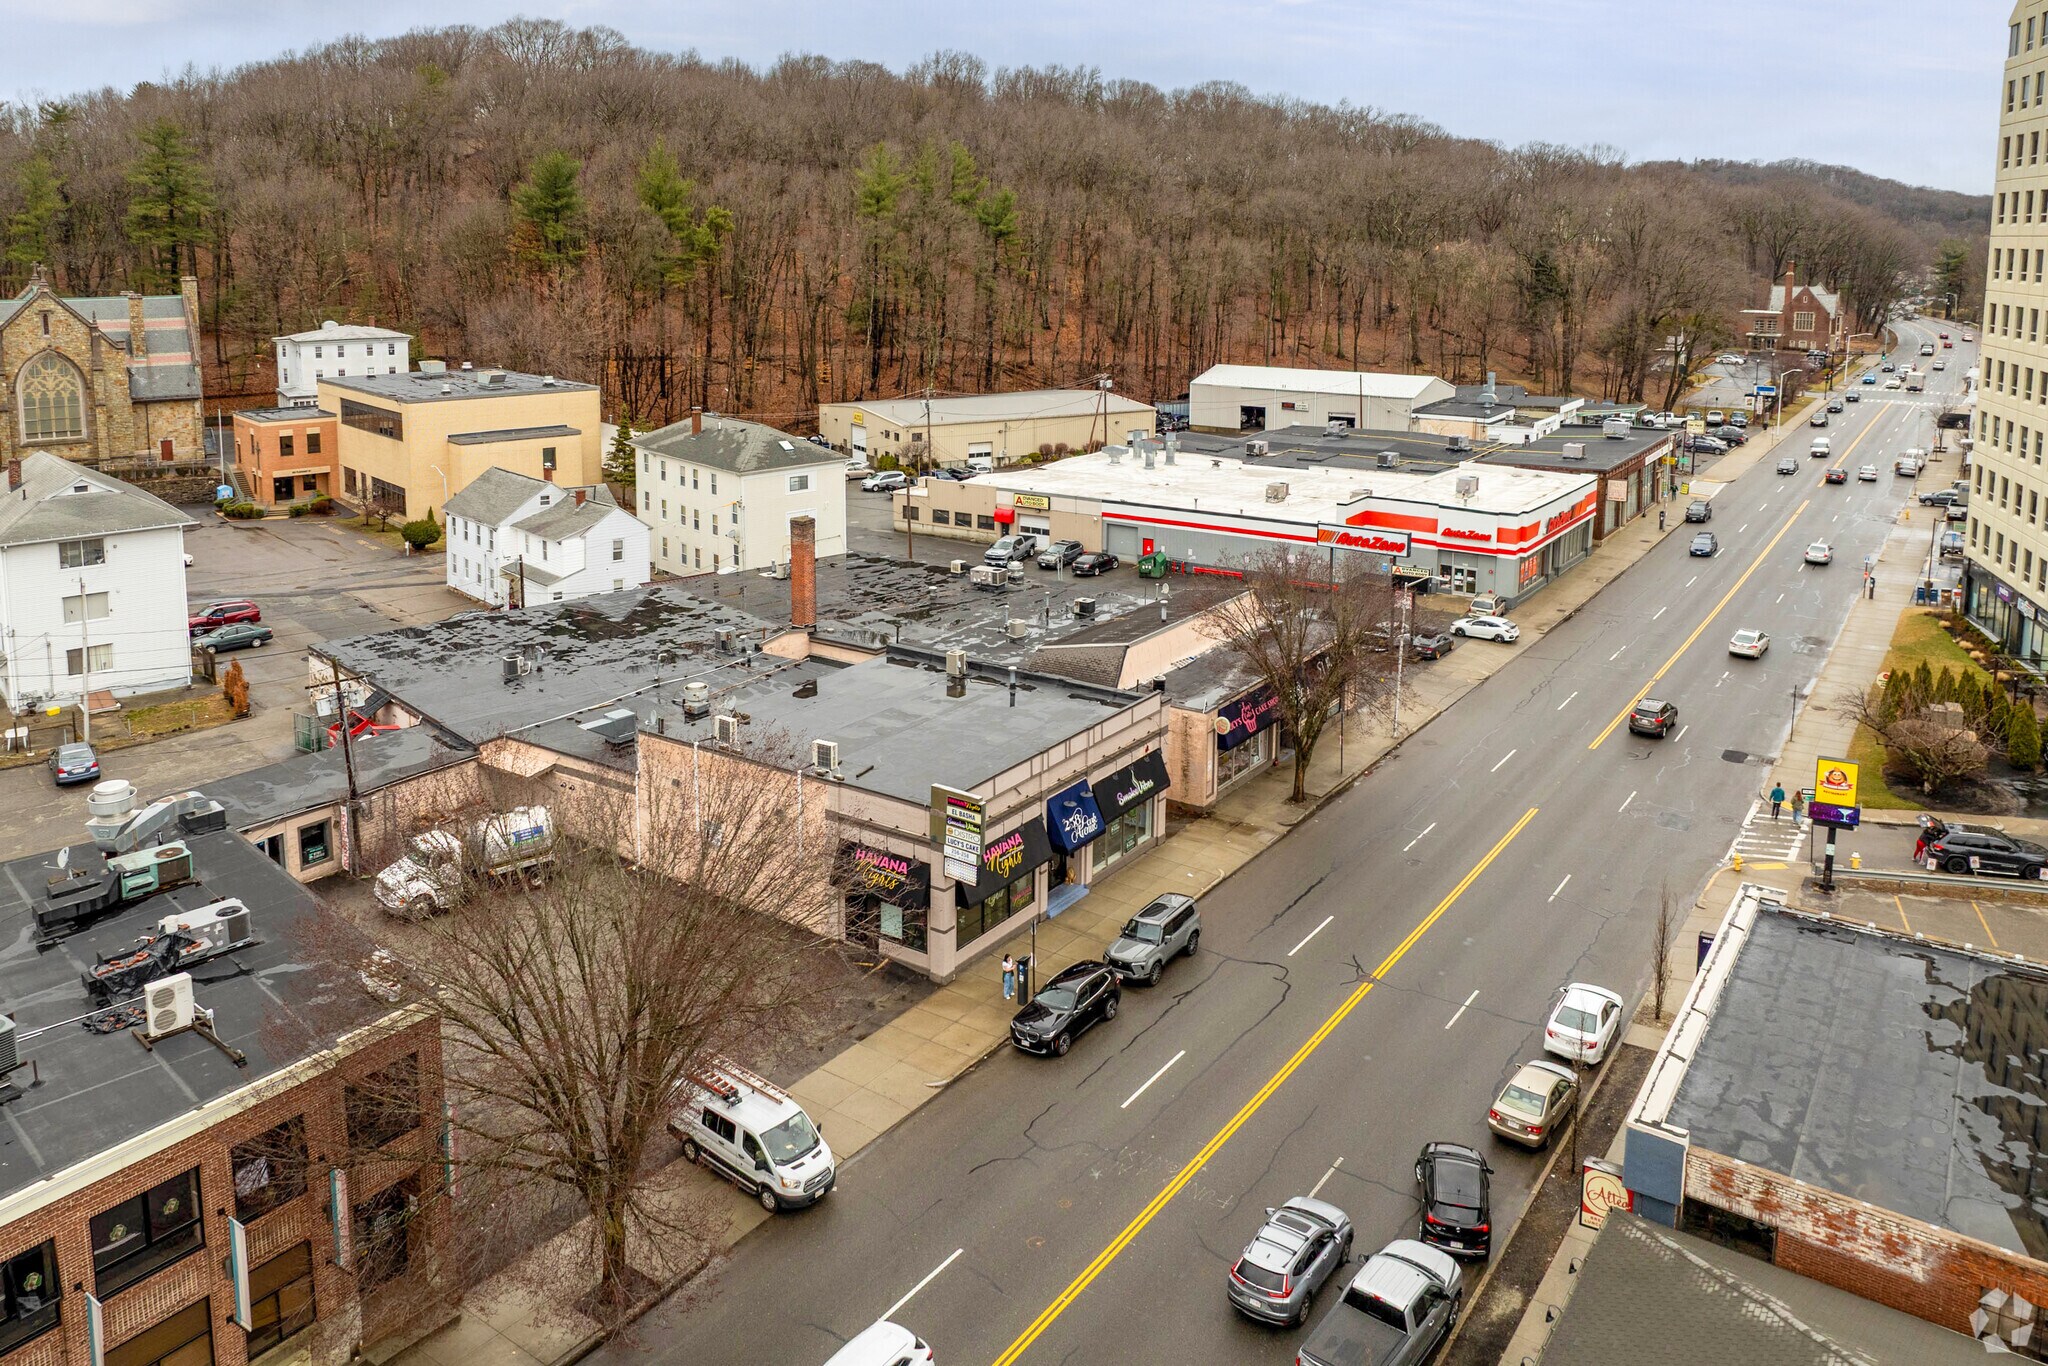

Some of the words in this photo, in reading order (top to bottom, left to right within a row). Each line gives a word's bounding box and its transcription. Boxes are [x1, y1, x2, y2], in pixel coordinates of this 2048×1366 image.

[1336, 532, 1406, 553] AutoZone
[1441, 527, 1492, 542] AutoZone
[1254, 702, 1268, 715] CAKE
[1116, 786, 1139, 806] Smoke
[951, 808, 959, 816] EL
[958, 810, 976, 821] BASHA
[1081, 812, 1098, 829] Park
[953, 828, 980, 842] DISTRO
[1071, 823, 1098, 843] Avenue
[947, 837, 965, 850] LUCY'S
[965, 842, 980, 853] CAKE
[982, 833, 1023, 863] HAVANA
[855, 848, 909, 875] HAVANA
[986, 847, 1024, 879] Nights
[851, 858, 900, 890] Nights
